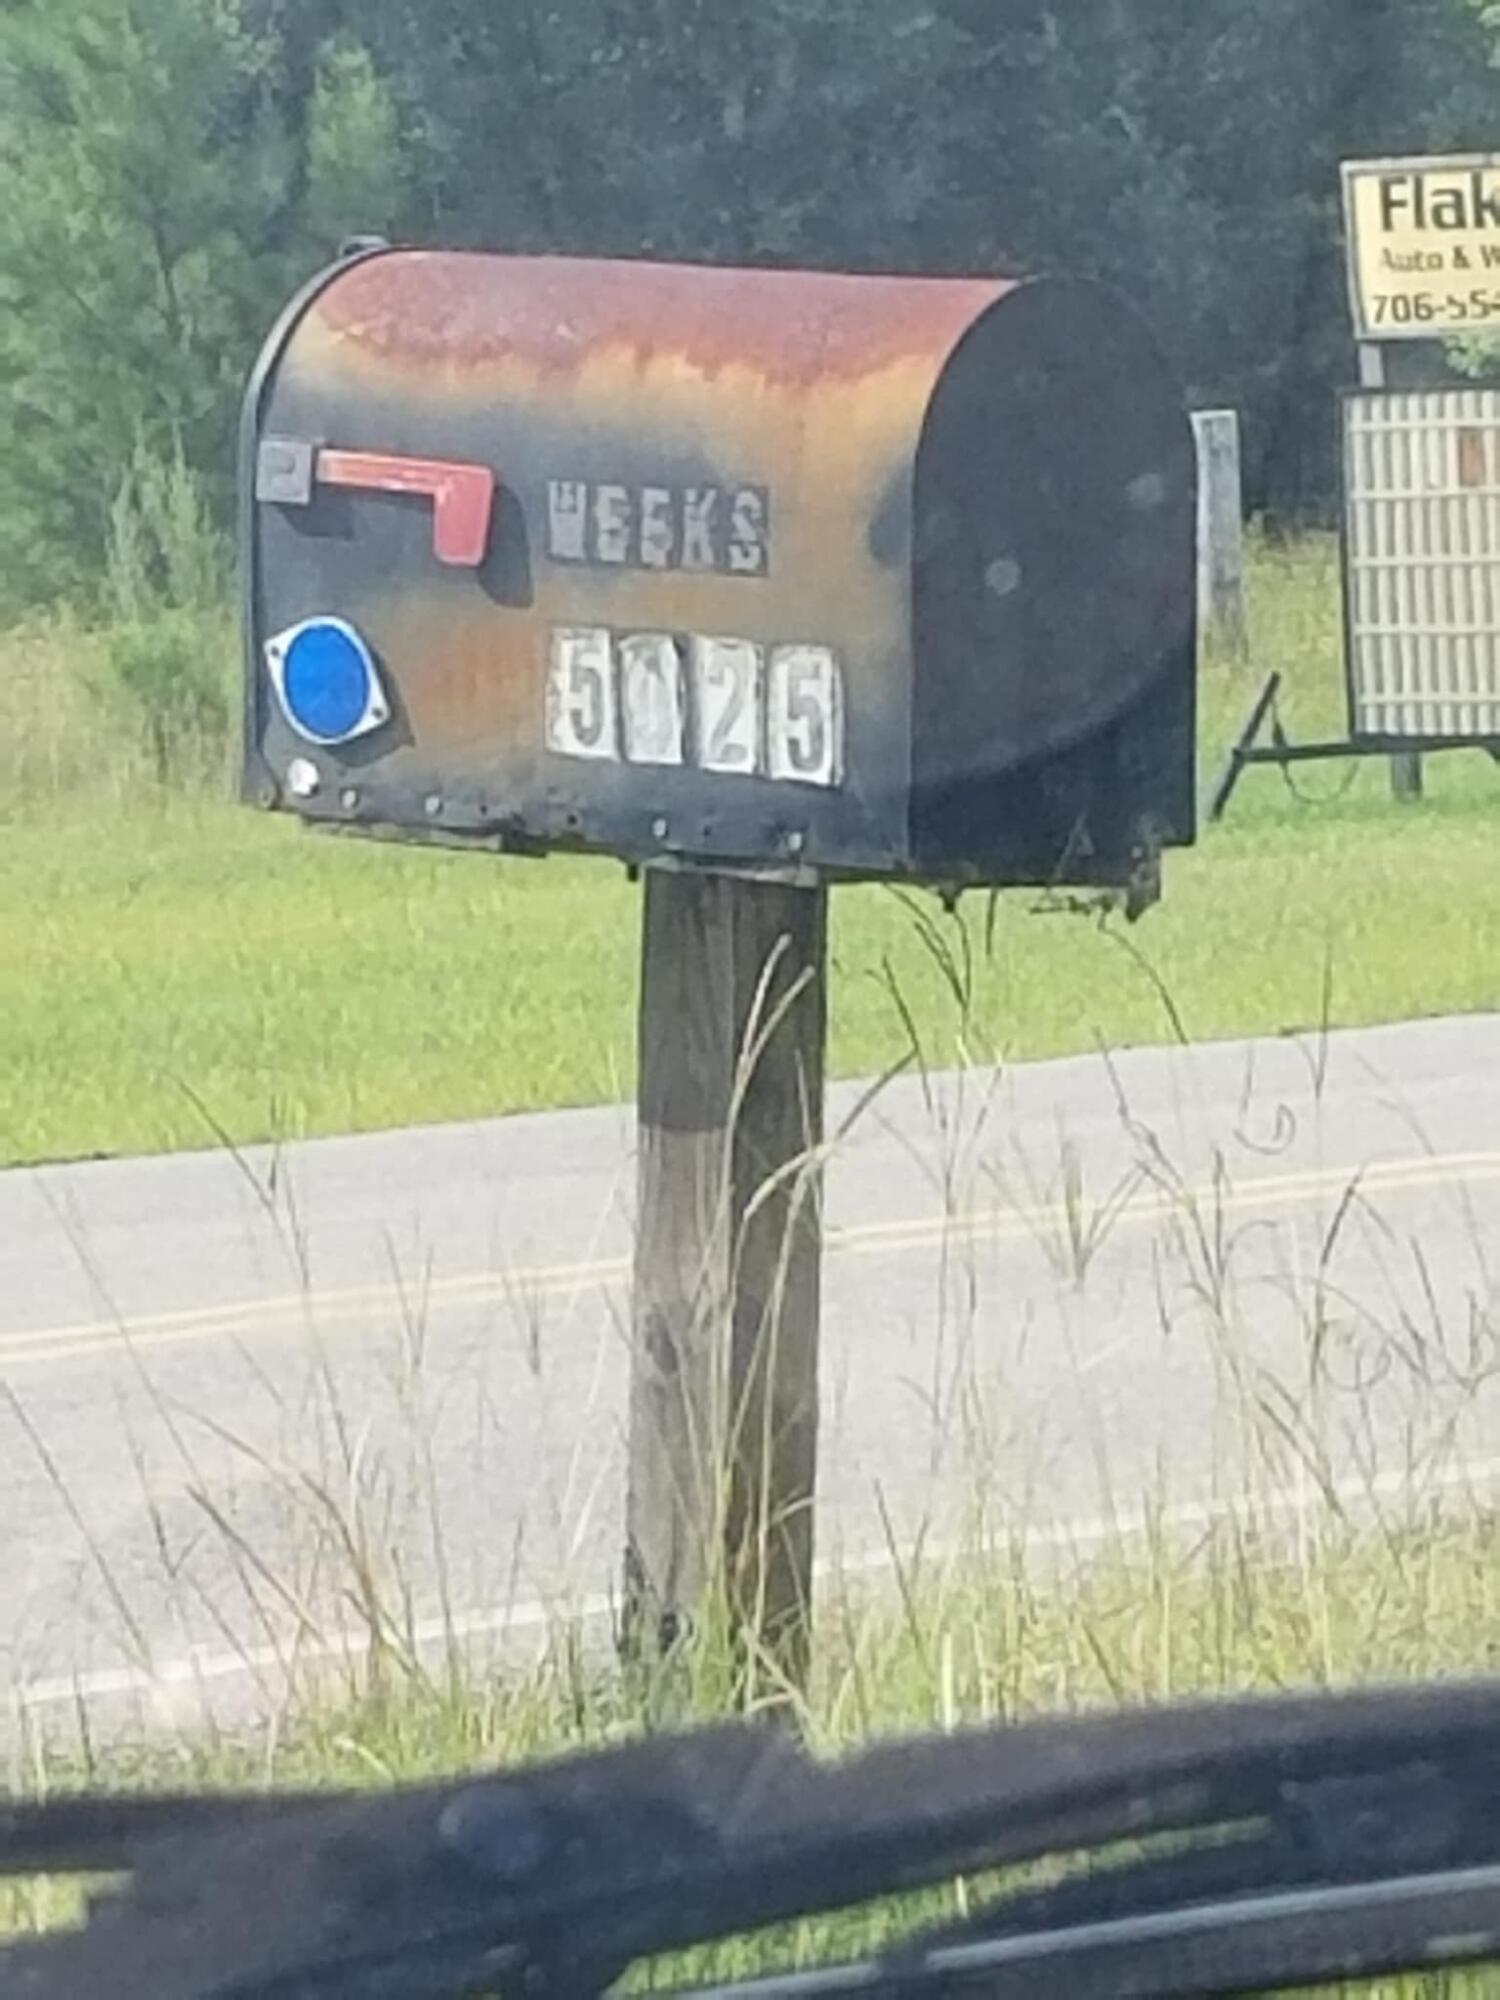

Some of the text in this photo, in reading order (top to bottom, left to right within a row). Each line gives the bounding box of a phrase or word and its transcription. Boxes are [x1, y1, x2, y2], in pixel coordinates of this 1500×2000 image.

[1381, 173, 1500, 231] Flak
[1383, 247, 1443, 271] Auto
[1453, 245, 1471, 268] &
[549, 481, 764, 570] WEEKS
